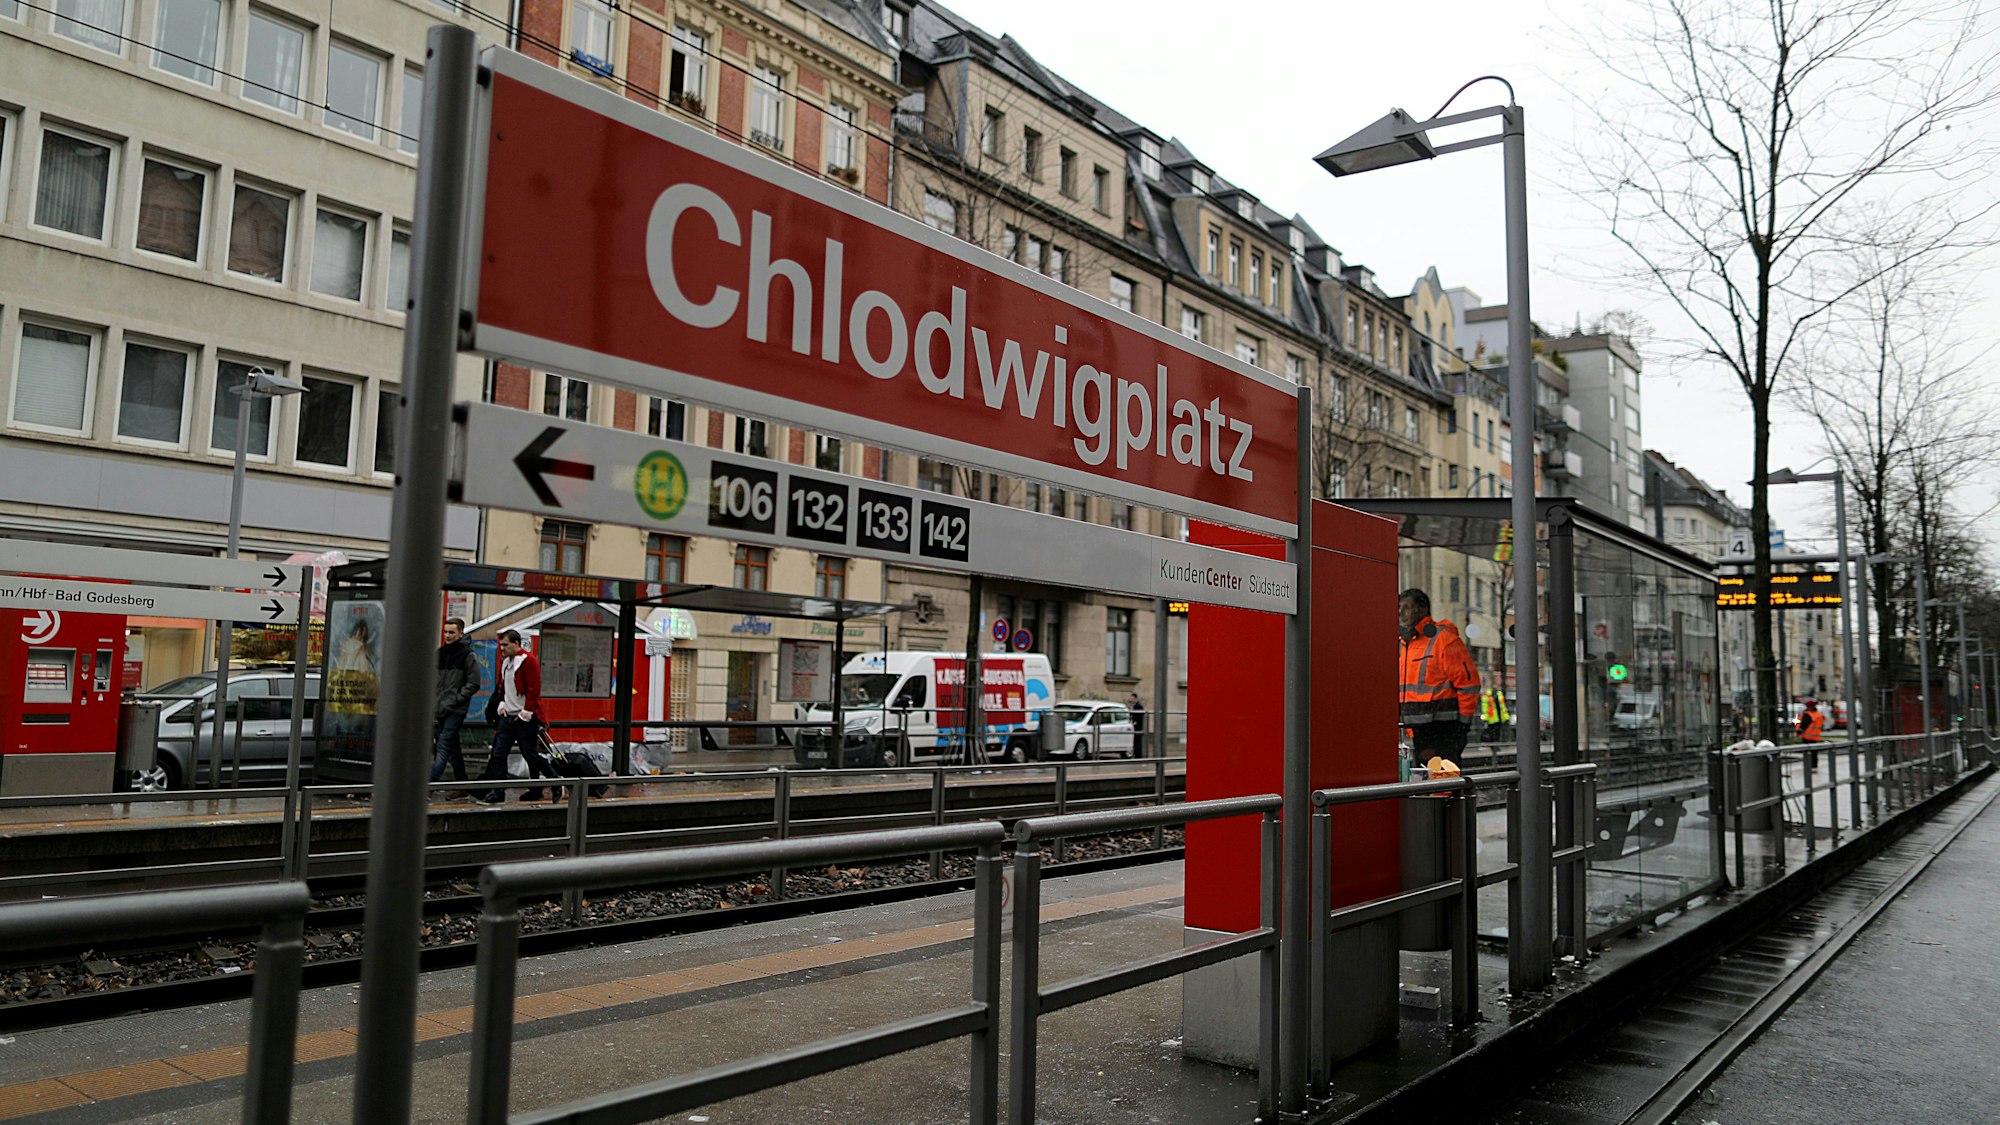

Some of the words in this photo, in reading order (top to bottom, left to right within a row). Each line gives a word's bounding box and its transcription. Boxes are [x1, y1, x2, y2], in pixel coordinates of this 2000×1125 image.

[646, 183, 1253, 481] Chlodwigplatz
[713, 475, 773, 521] 106
[792, 489, 844, 532] 132
[861, 501, 909, 542] 133
[924, 512, 967, 551] 142
[1732, 540, 1746, 555] 4
[1160, 558, 1243, 591] KundenCenter
[1249, 574, 1290, 598] Südstadt
[86, 592, 155, 609] Godesberg
